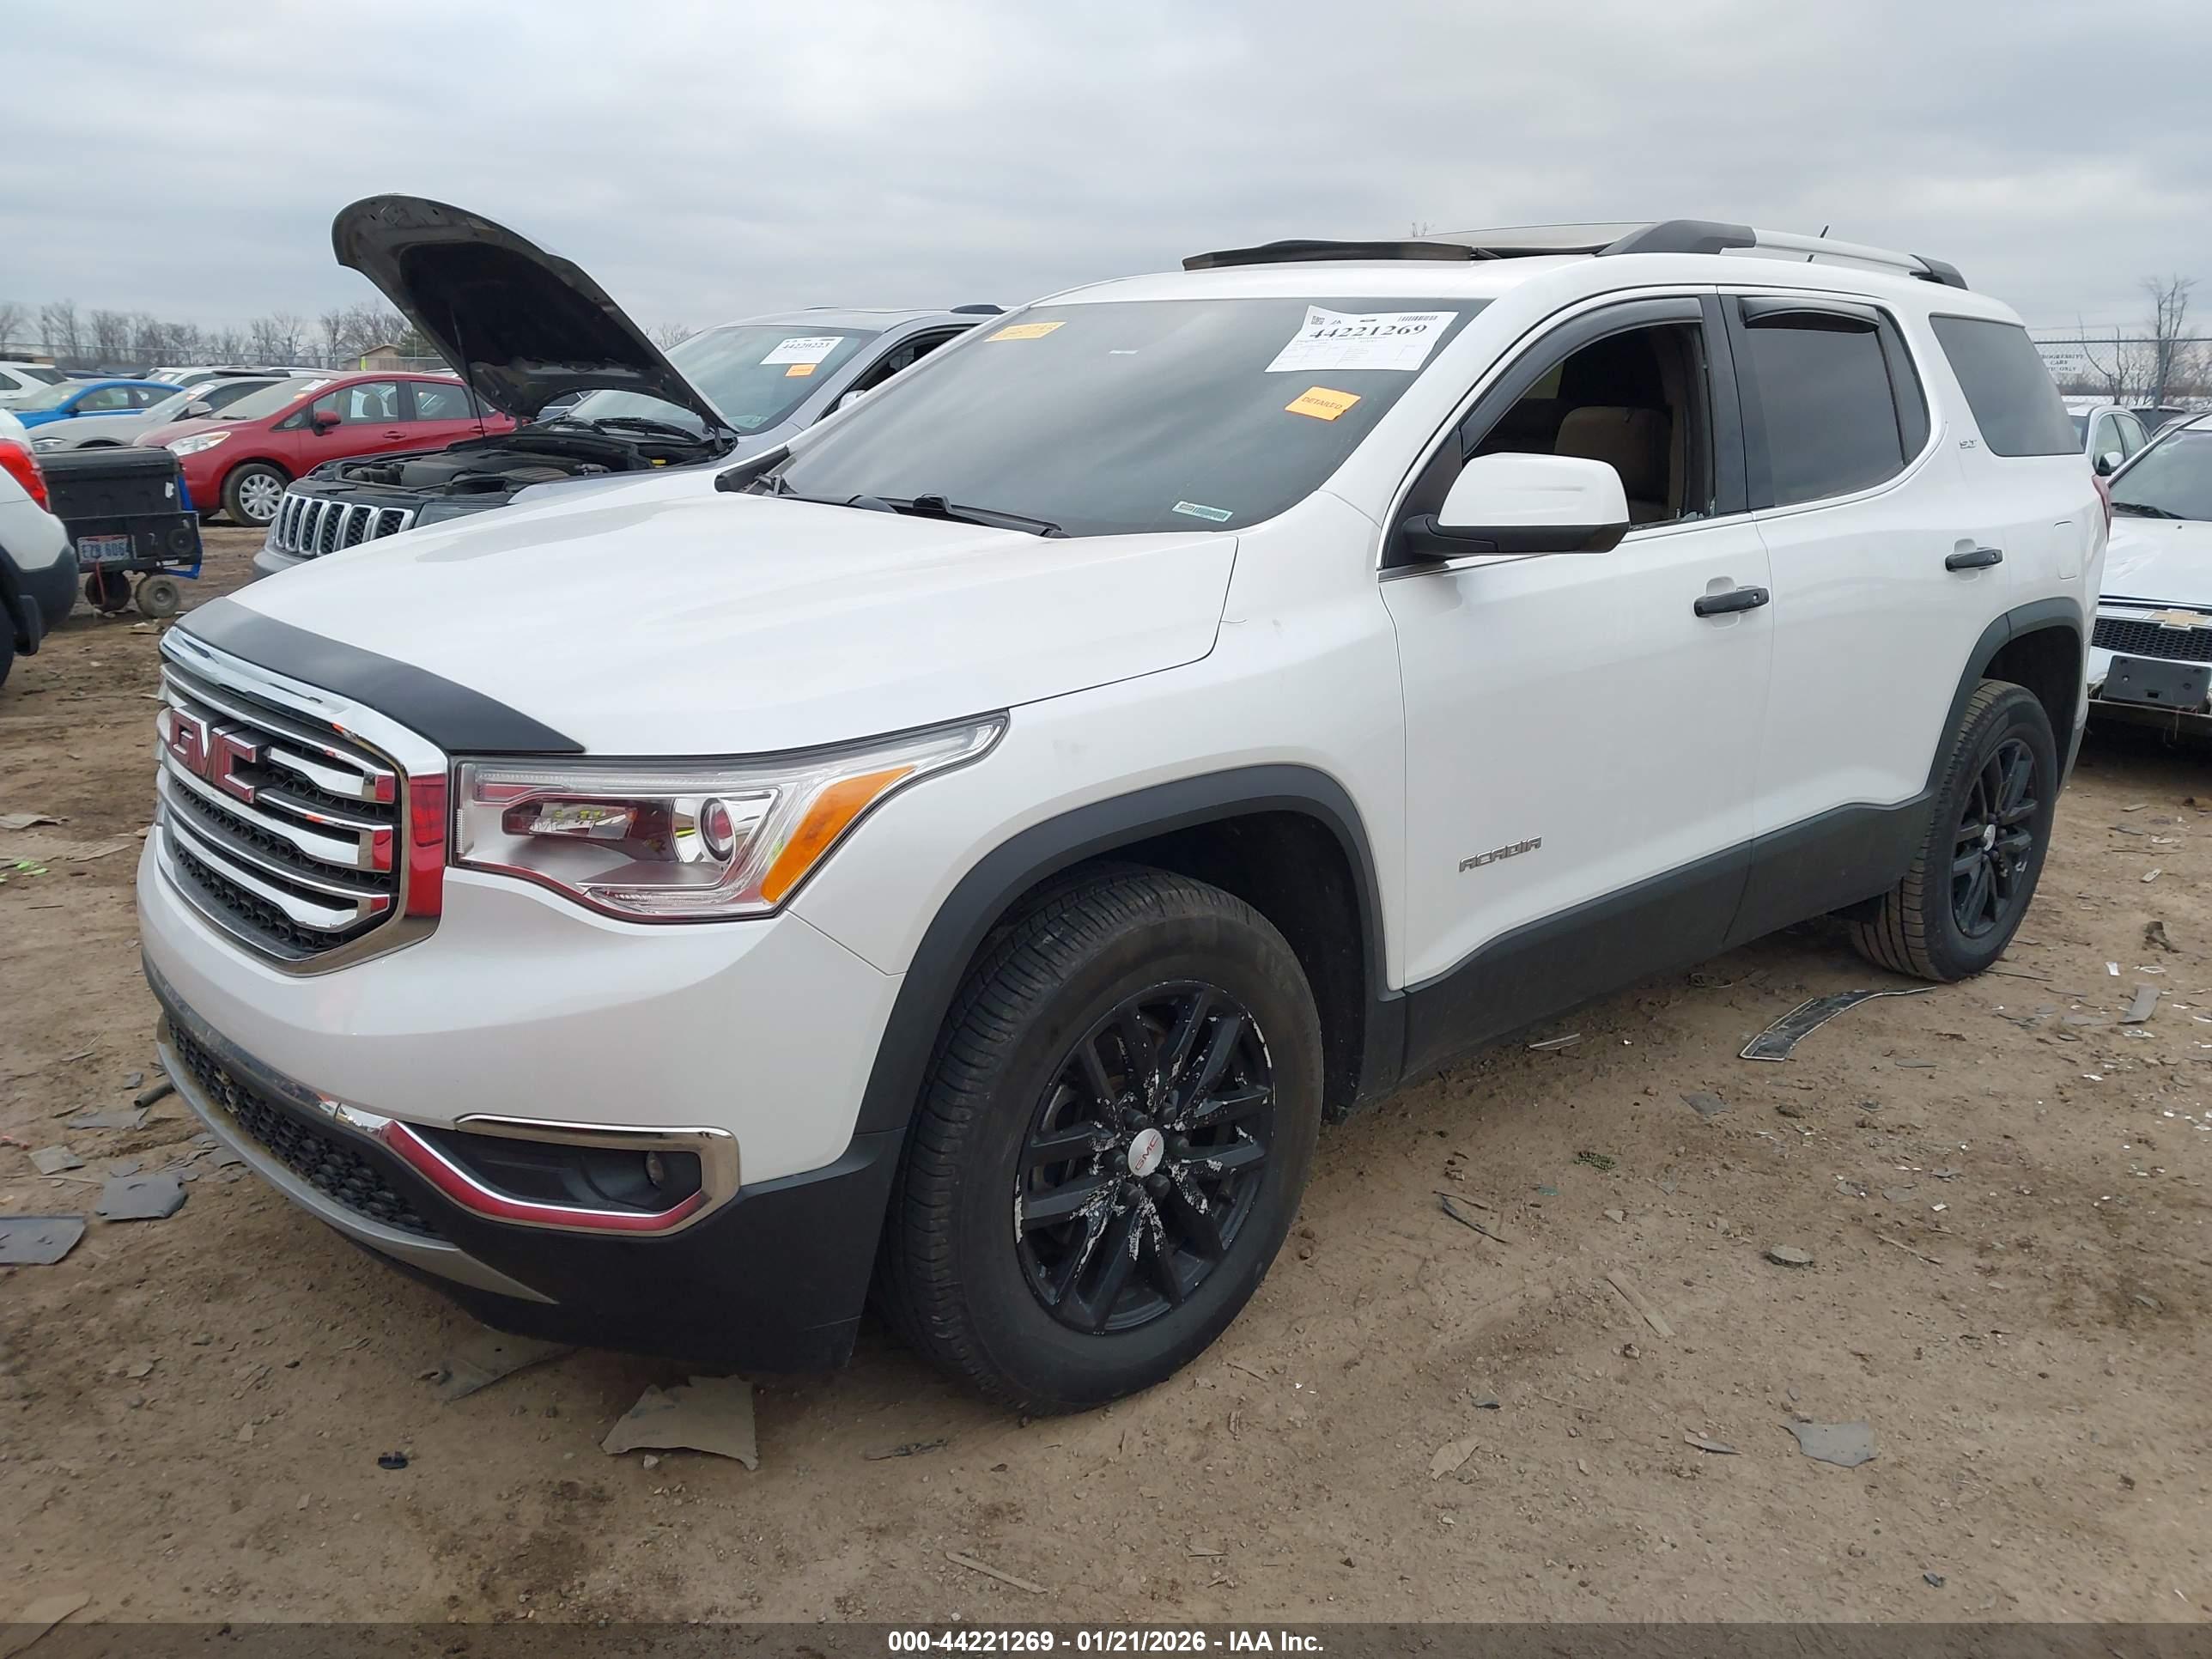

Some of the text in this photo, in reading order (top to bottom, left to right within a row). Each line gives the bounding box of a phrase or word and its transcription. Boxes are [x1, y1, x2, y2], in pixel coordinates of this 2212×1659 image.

[1310, 324, 1428, 338] 44221269
[1302, 397, 1343, 410] DETAILED
[167, 708, 256, 804] GMC
[1459, 836, 1542, 872] ACADIA
[1134, 1134, 1158, 1171] GMC
